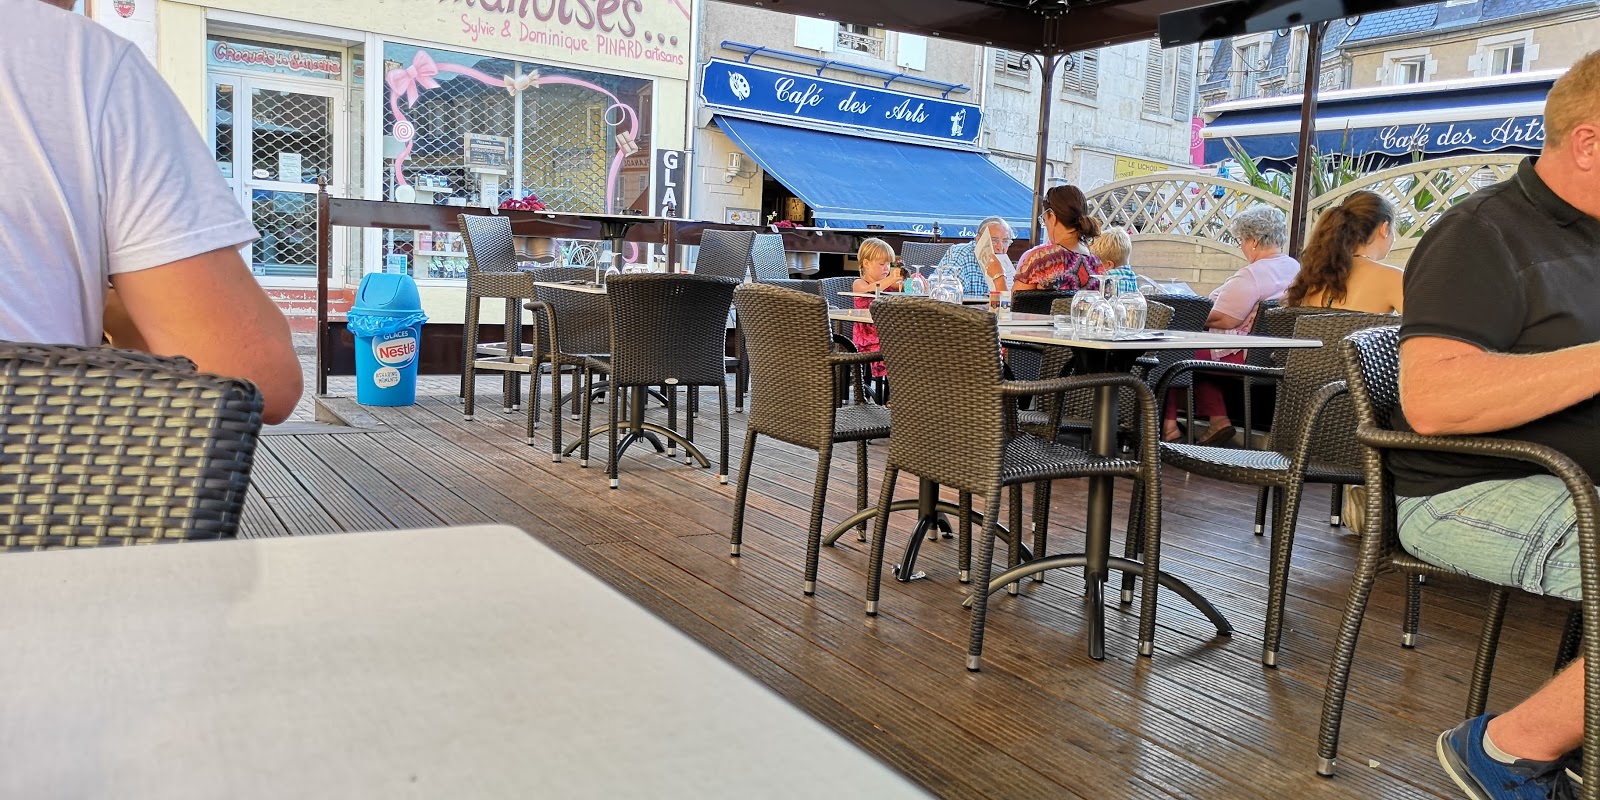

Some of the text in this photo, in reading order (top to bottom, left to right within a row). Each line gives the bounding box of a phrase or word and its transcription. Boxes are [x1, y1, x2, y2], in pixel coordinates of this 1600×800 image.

[461, 14, 684, 66] Sylvie & Dominique PINARD artisans
[774, 77, 930, 124] Café des Arts
[1380, 116, 1546, 152] Café des Arts
[1128, 161, 1136, 169] LE
[912, 223, 944, 236] Caé
[383, 330, 409, 340] GLACES
[379, 341, 415, 359] Nestlé
